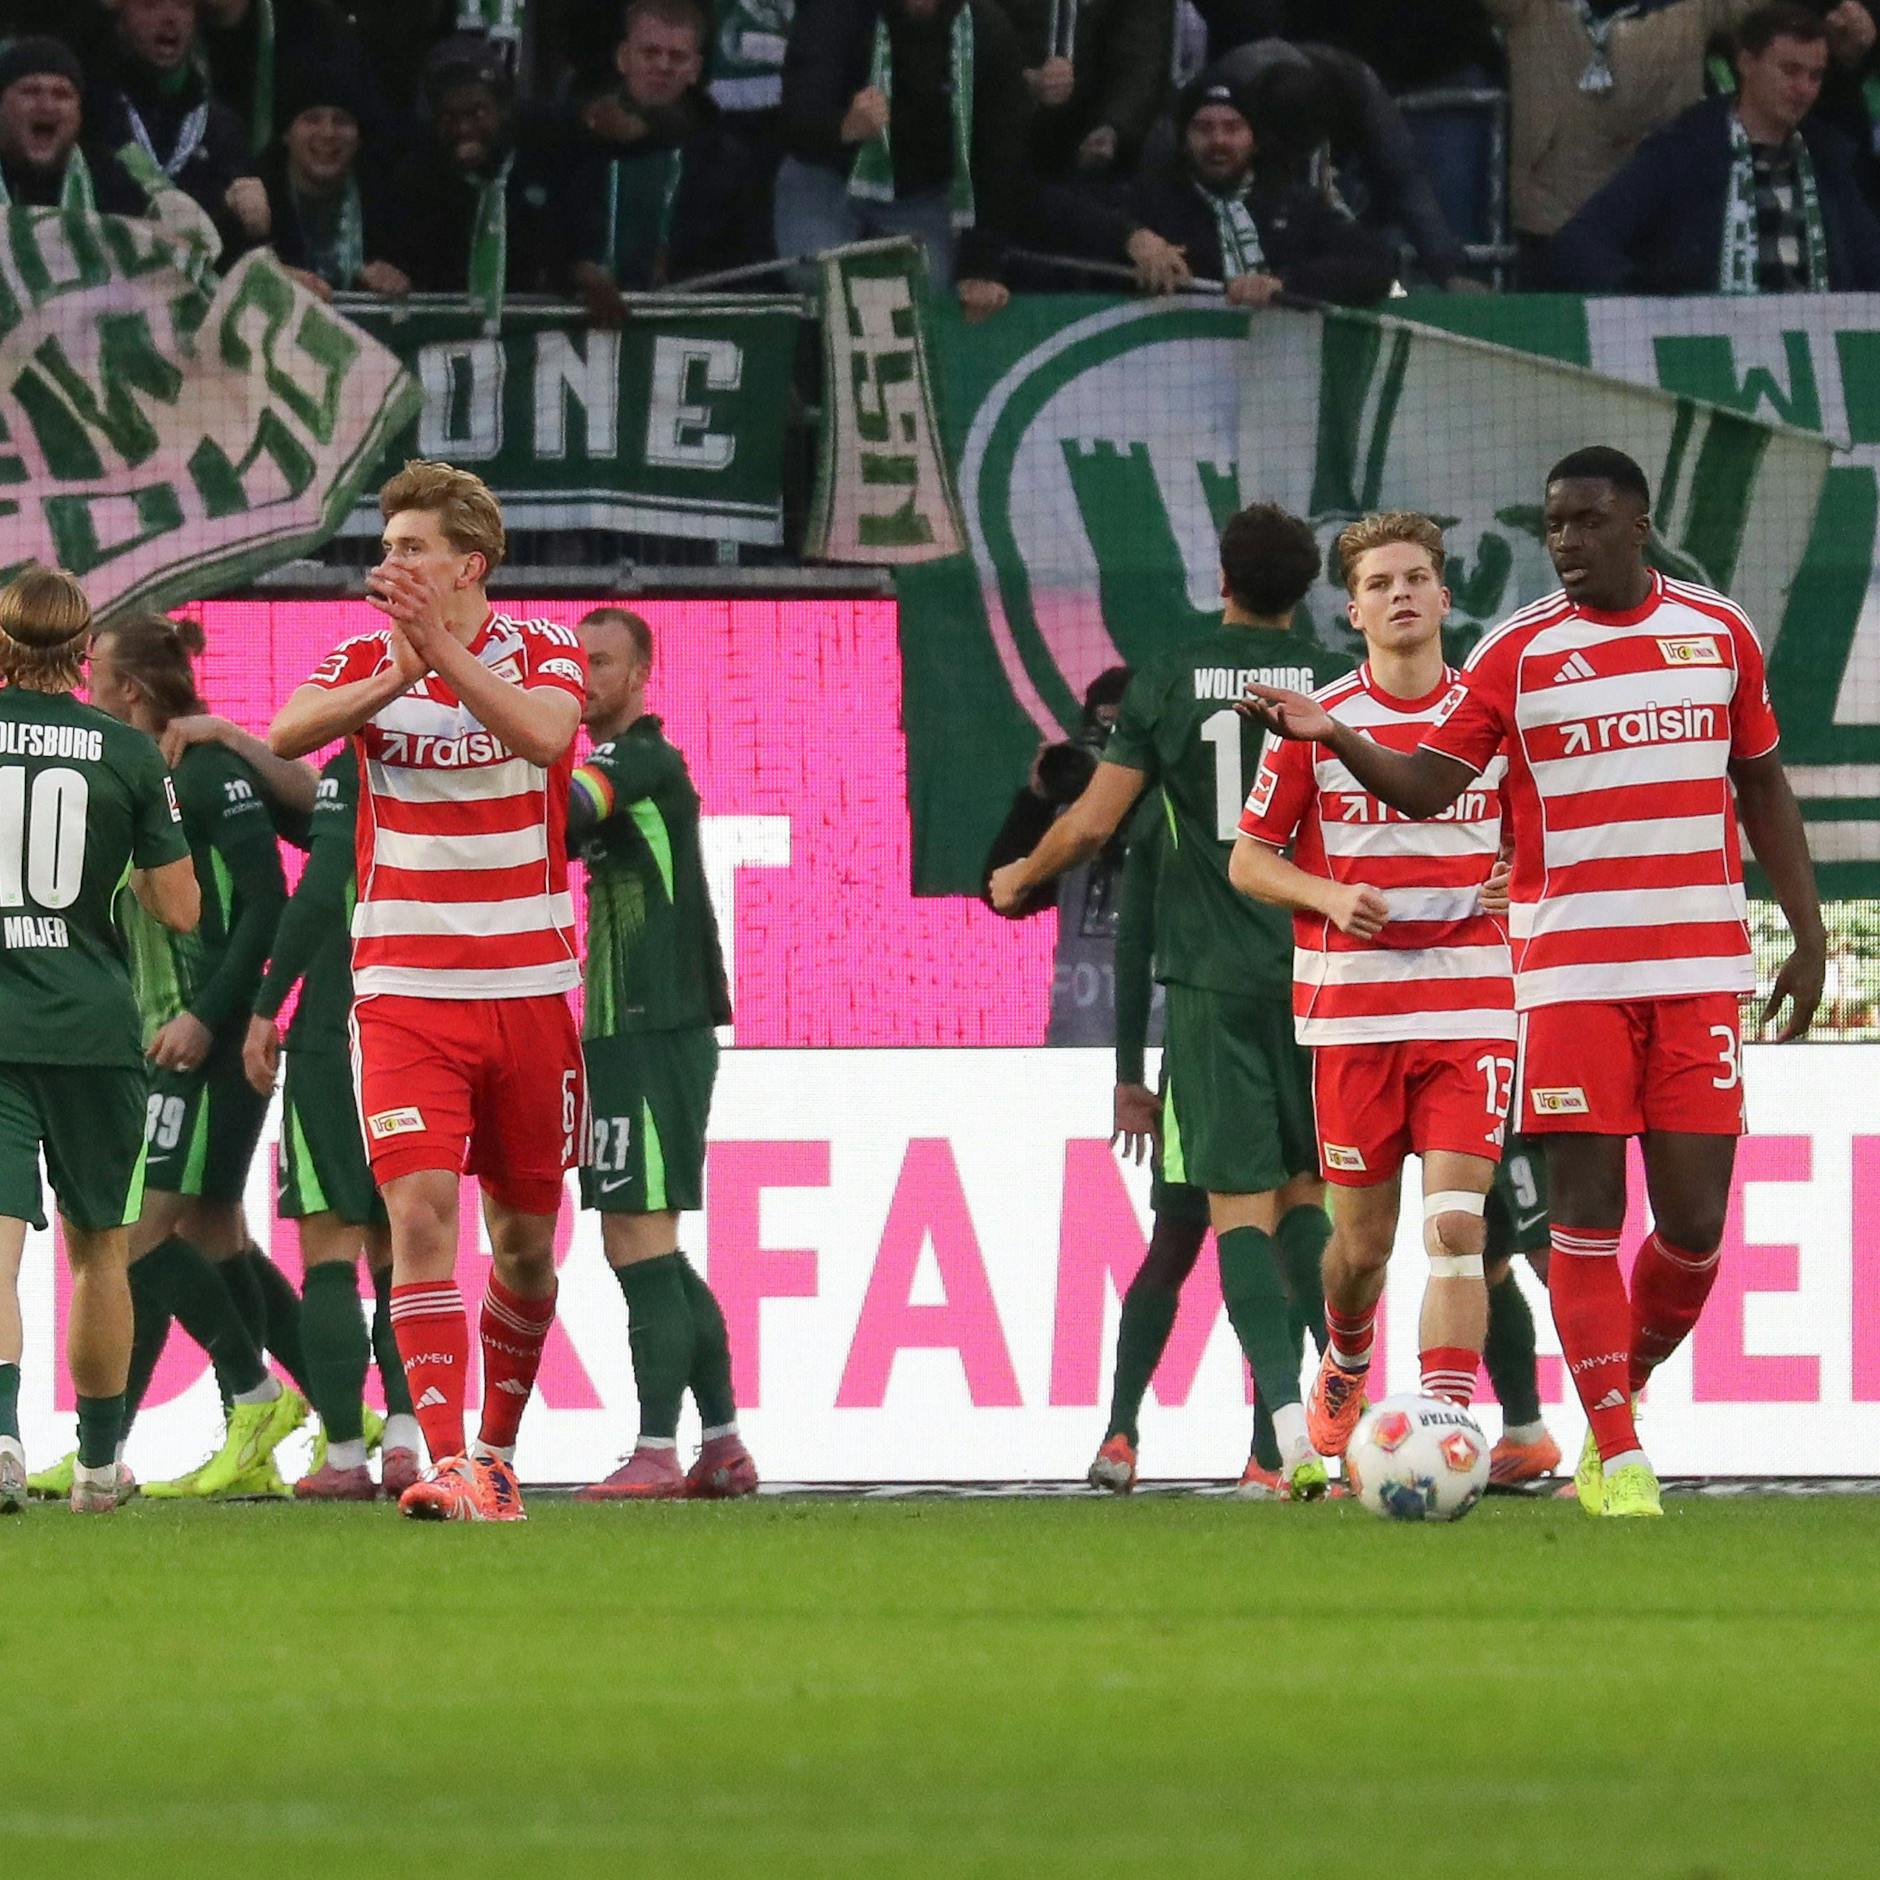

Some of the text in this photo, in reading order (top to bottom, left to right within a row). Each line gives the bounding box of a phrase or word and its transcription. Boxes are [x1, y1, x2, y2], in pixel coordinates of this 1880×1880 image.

[418, 330, 743, 471] ONE
[414, 726, 513, 767] raisi
[1598, 698, 1714, 747] raisin
[0, 765, 89, 909] 10
[3, 916, 69, 949] MAJER
[561, 1069, 576, 1134] 6
[1476, 1054, 1515, 1118] 13
[594, 1116, 631, 1171] 27
